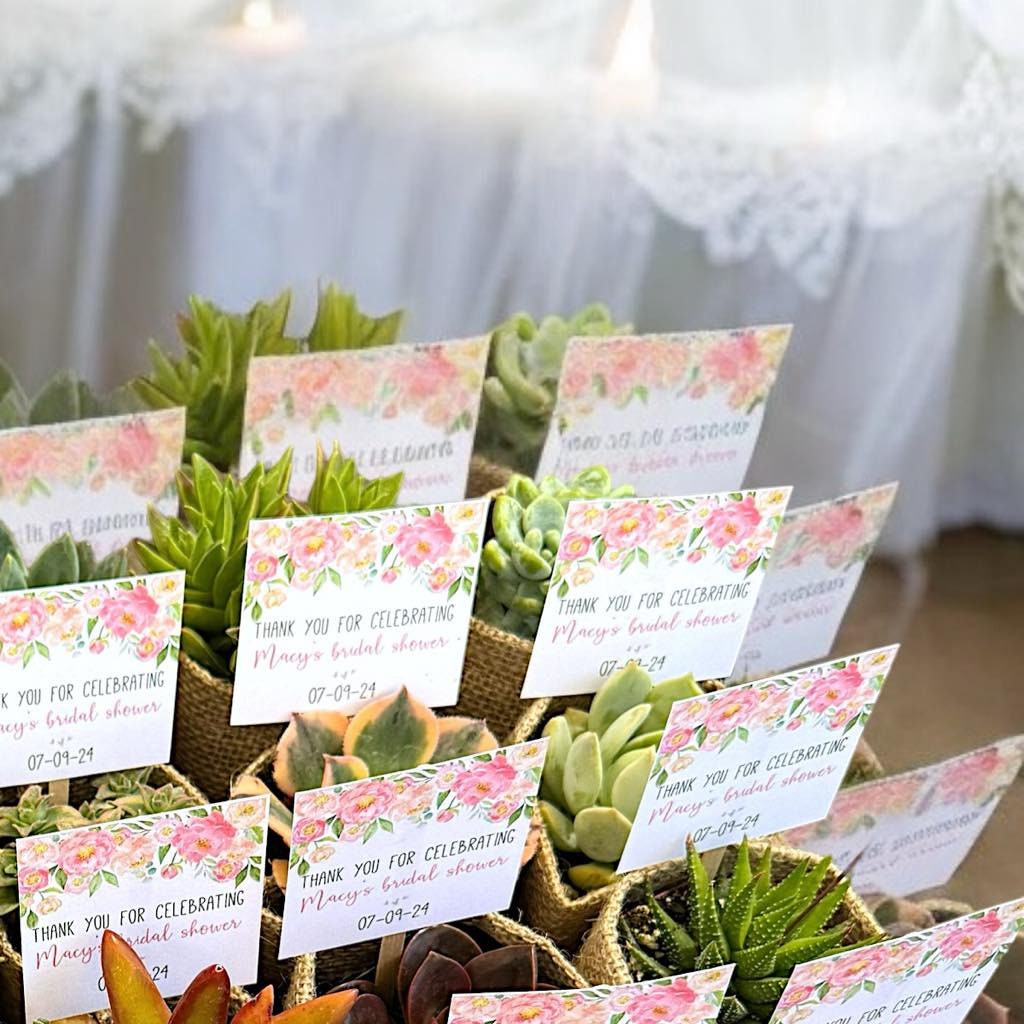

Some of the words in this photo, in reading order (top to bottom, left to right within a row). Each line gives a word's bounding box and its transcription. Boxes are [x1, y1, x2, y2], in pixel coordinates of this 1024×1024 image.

[557, 596, 599, 616] THANK
[605, 595, 632, 613] YOU
[637, 591, 664, 610] FOR
[669, 582, 750, 607] CELEBRATING
[255, 619, 296, 639] THANK
[304, 617, 329, 636] YOU
[337, 614, 363, 633] FOR
[370, 604, 455, 630] CELEBRATING
[550, 616, 621, 646] Macy's
[627, 610, 680, 636] bridal
[685, 609, 740, 629] shower
[253, 640, 324, 671] Macy's
[330, 633, 385, 661] bridal
[391, 632, 449, 654] shower
[17, 688, 42, 707] YOU
[50, 683, 74, 703] FOR
[82, 670, 165, 699] CELEBRATING
[307, 681, 376, 705] 07-09-24
[45, 701, 99, 729] bridal
[105, 699, 162, 720] shower
[27, 746, 94, 771] 07-09-24
[656, 777, 697, 800] THANK
[703, 768, 729, 788] YOU
[734, 760, 761, 780] FOR
[766, 736, 849, 772] CELEBRATING
[648, 790, 717, 825] Macy's
[722, 773, 776, 804] bridal
[780, 765, 837, 788] shower
[692, 812, 760, 844] 07-09-24
[302, 867, 344, 889] THANK
[353, 859, 380, 878] YOU
[388, 850, 416, 870] FOR
[424, 827, 516, 863] CELEBRATING
[300, 880, 374, 913] Macy's
[381, 863, 440, 893] bridal
[446, 855, 509, 878] shower
[32, 920, 75, 942] THANK
[84, 914, 110, 932] YOU
[120, 907, 146, 926] FOR
[155, 889, 245, 921] CELEBRATING
[126, 923, 174, 948] ridal
[180, 918, 242, 939] shower
[357, 902, 430, 931] 07-09-24
[891, 973, 981, 1014] CELEBRATING
[905, 999, 964, 1024] shower
